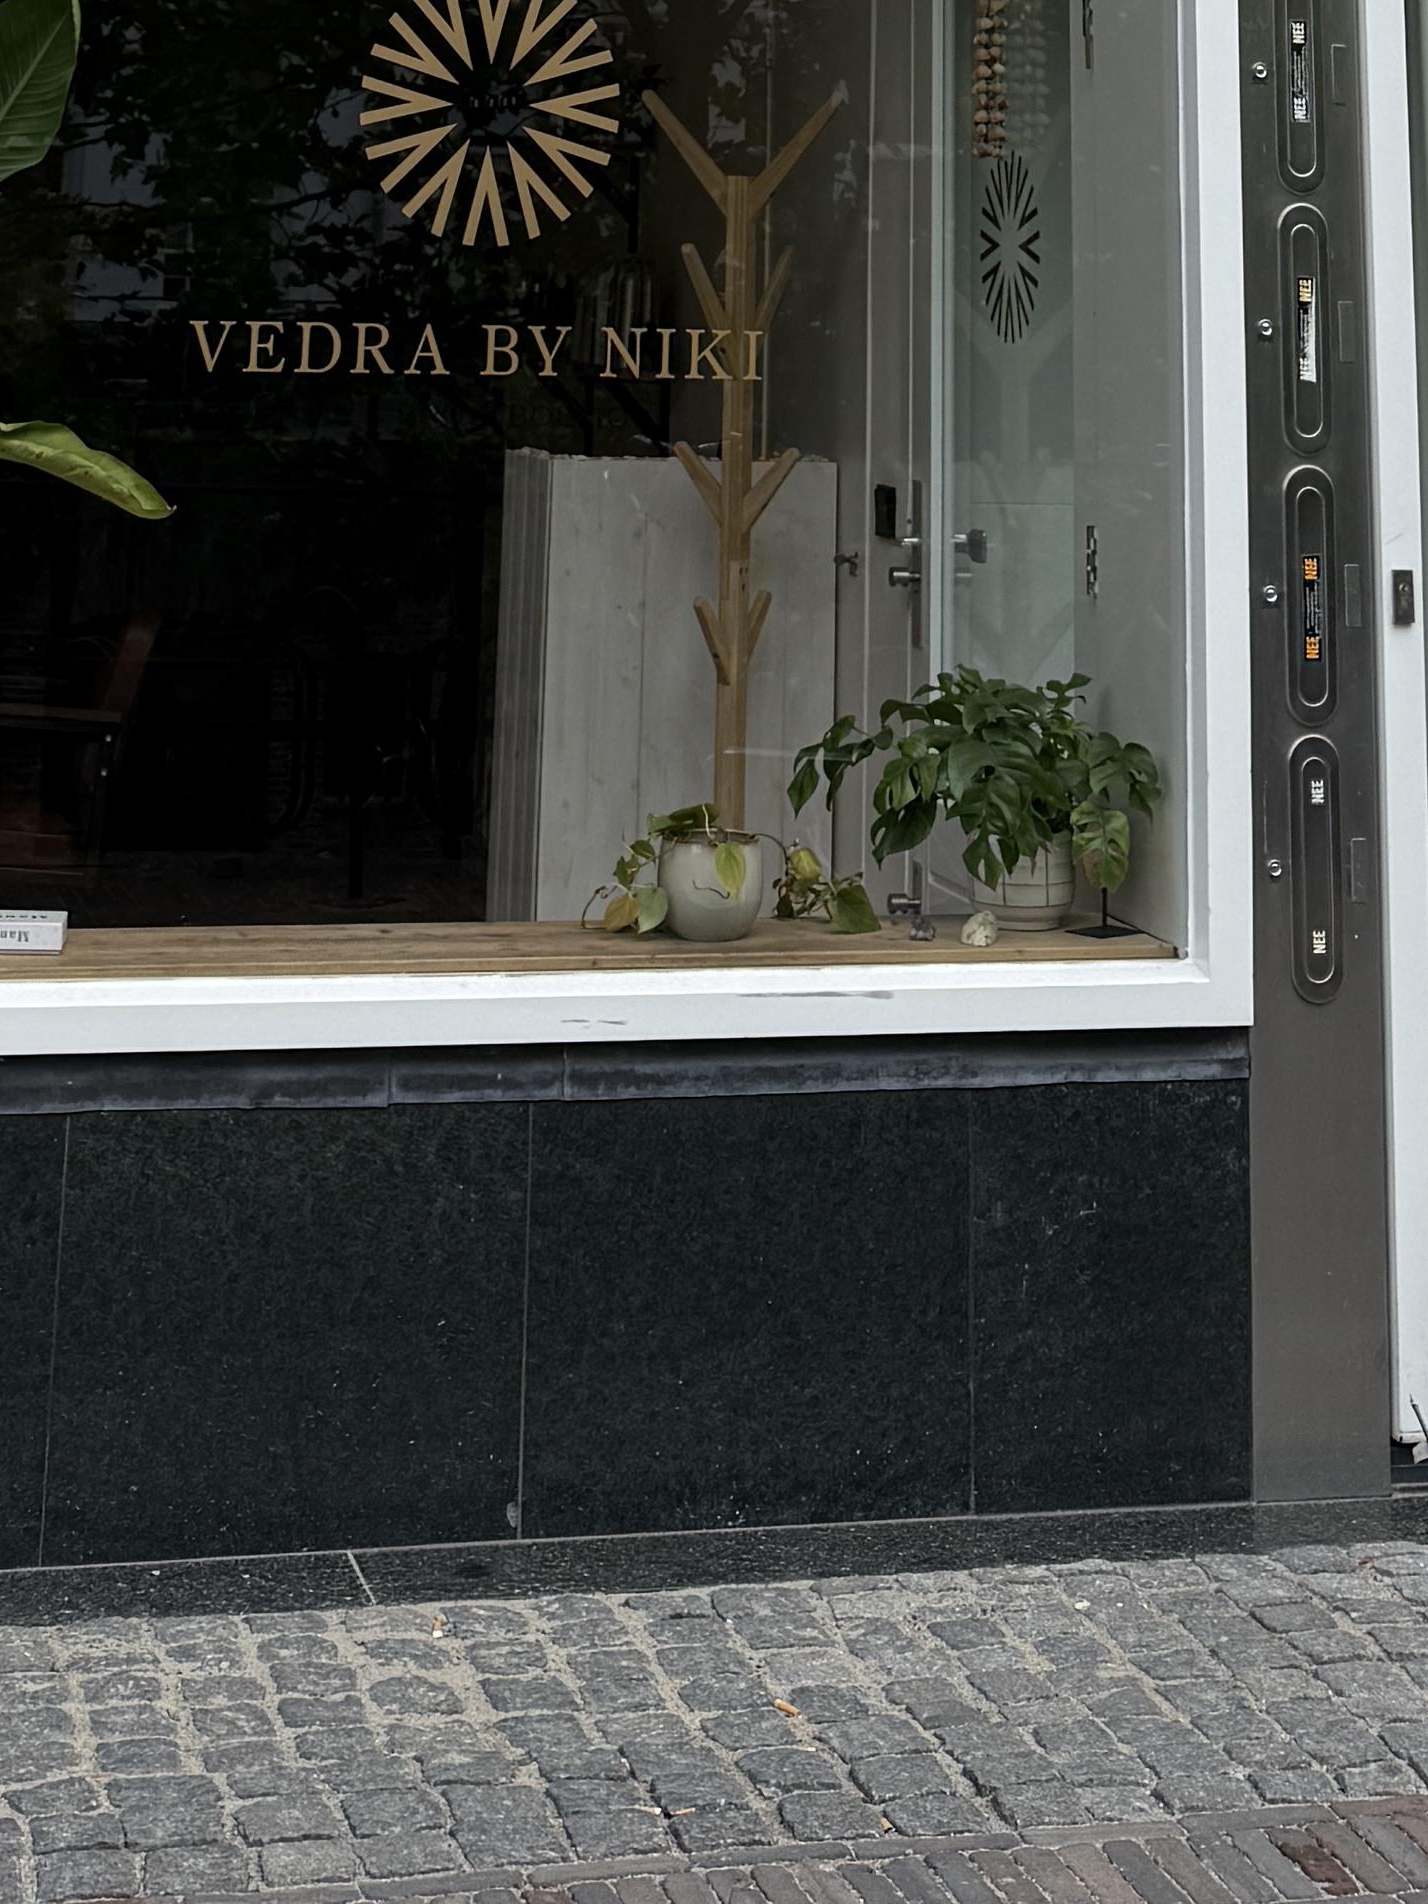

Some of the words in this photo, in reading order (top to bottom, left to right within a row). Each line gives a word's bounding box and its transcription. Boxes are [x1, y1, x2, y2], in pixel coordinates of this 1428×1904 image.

[1291, 22, 1306, 44] NEE
[189, 319, 451, 376] VEDRA
[480, 323, 573, 378] BY
[599, 325, 766, 382] NIKI
[1311, 778, 1325, 805] NEE
[1313, 929, 1327, 955] NEE
